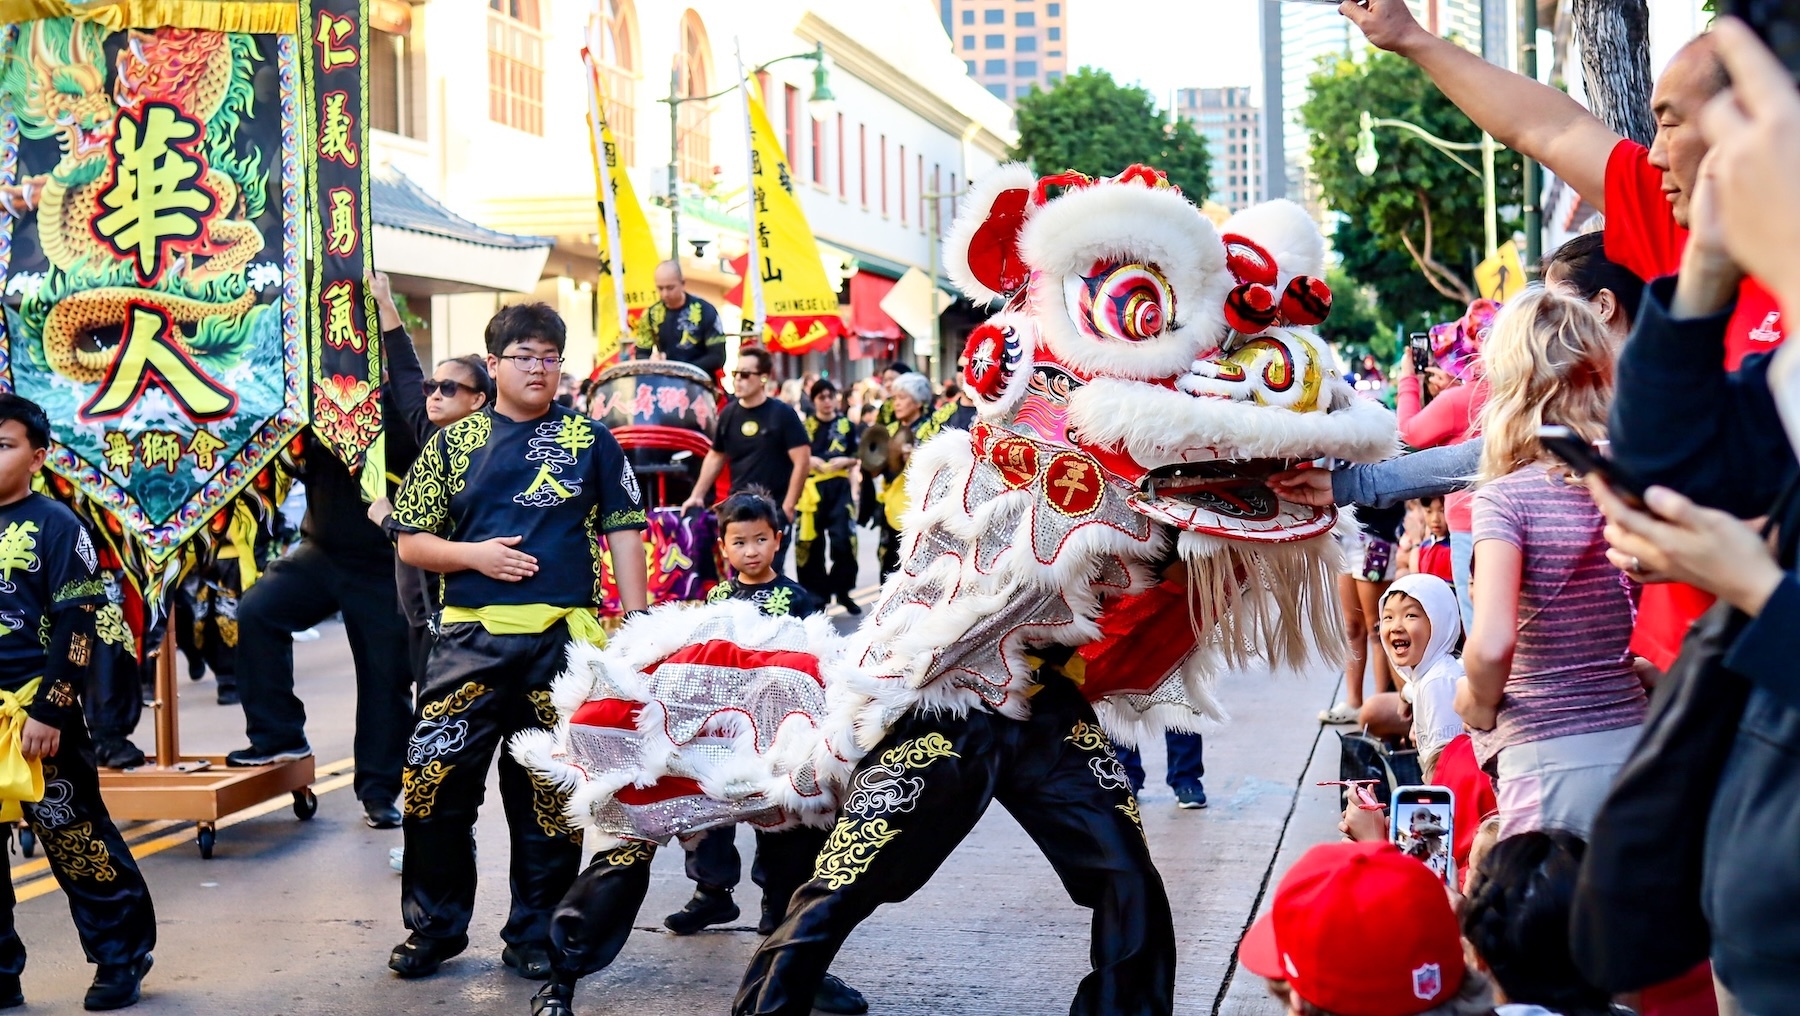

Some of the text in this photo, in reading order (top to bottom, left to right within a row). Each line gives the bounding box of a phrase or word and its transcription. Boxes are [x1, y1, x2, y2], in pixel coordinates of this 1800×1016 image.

[317, 14, 362, 351] 仁義勇氣
[97, 107, 231, 415] 華人
[775, 299, 817, 312] CHINESE
[103, 429, 227, 477] 舞獅會
[524, 415, 594, 499] 華人
